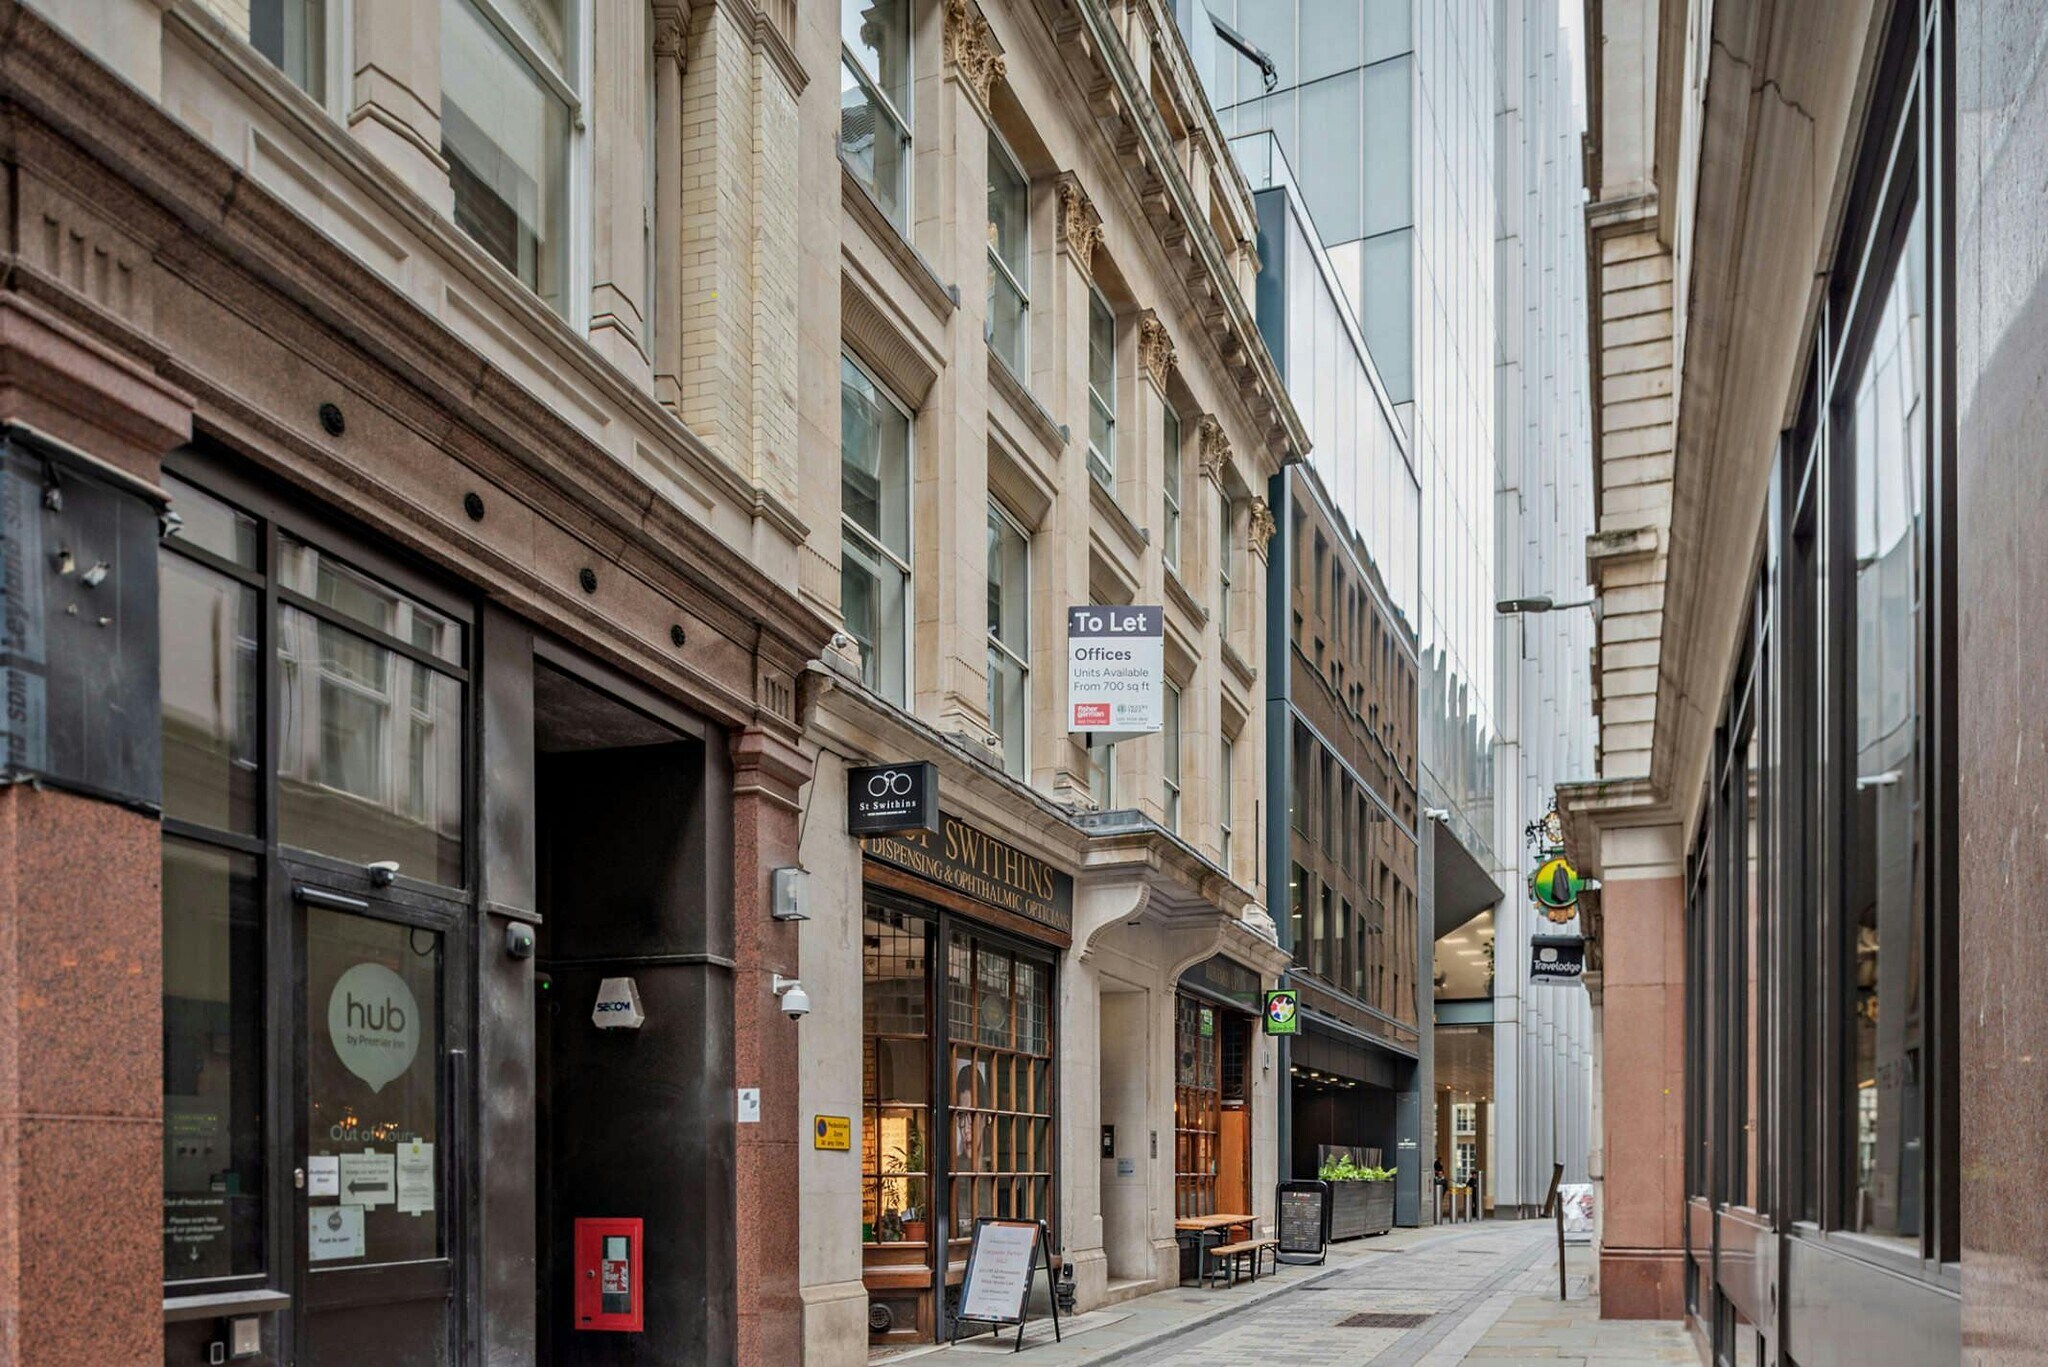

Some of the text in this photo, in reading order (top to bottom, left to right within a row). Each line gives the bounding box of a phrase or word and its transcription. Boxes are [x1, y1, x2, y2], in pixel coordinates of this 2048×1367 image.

[1075, 612, 1147, 632] To Let
[1075, 648, 1132, 661] Offices
[1074, 668, 1149, 678] Units Available
[1074, 682, 1150, 693] From 700 sq ft
[859, 799, 917, 811] St Swithins
[945, 819, 1054, 901] SWITHINS
[872, 837, 943, 880] DISPENSING
[944, 866, 953, 883] &
[954, 869, 1023, 912] OPHTHALMIC
[1025, 899, 1070, 931] OPTICIANS
[1534, 960, 1581, 974] Travelodge
[347, 992, 406, 1033] hub
[597, 1002, 630, 1012] SECOM
[346, 1035, 357, 1047] by
[330, 1124, 358, 1142] Out
[361, 1126, 375, 1142] of
